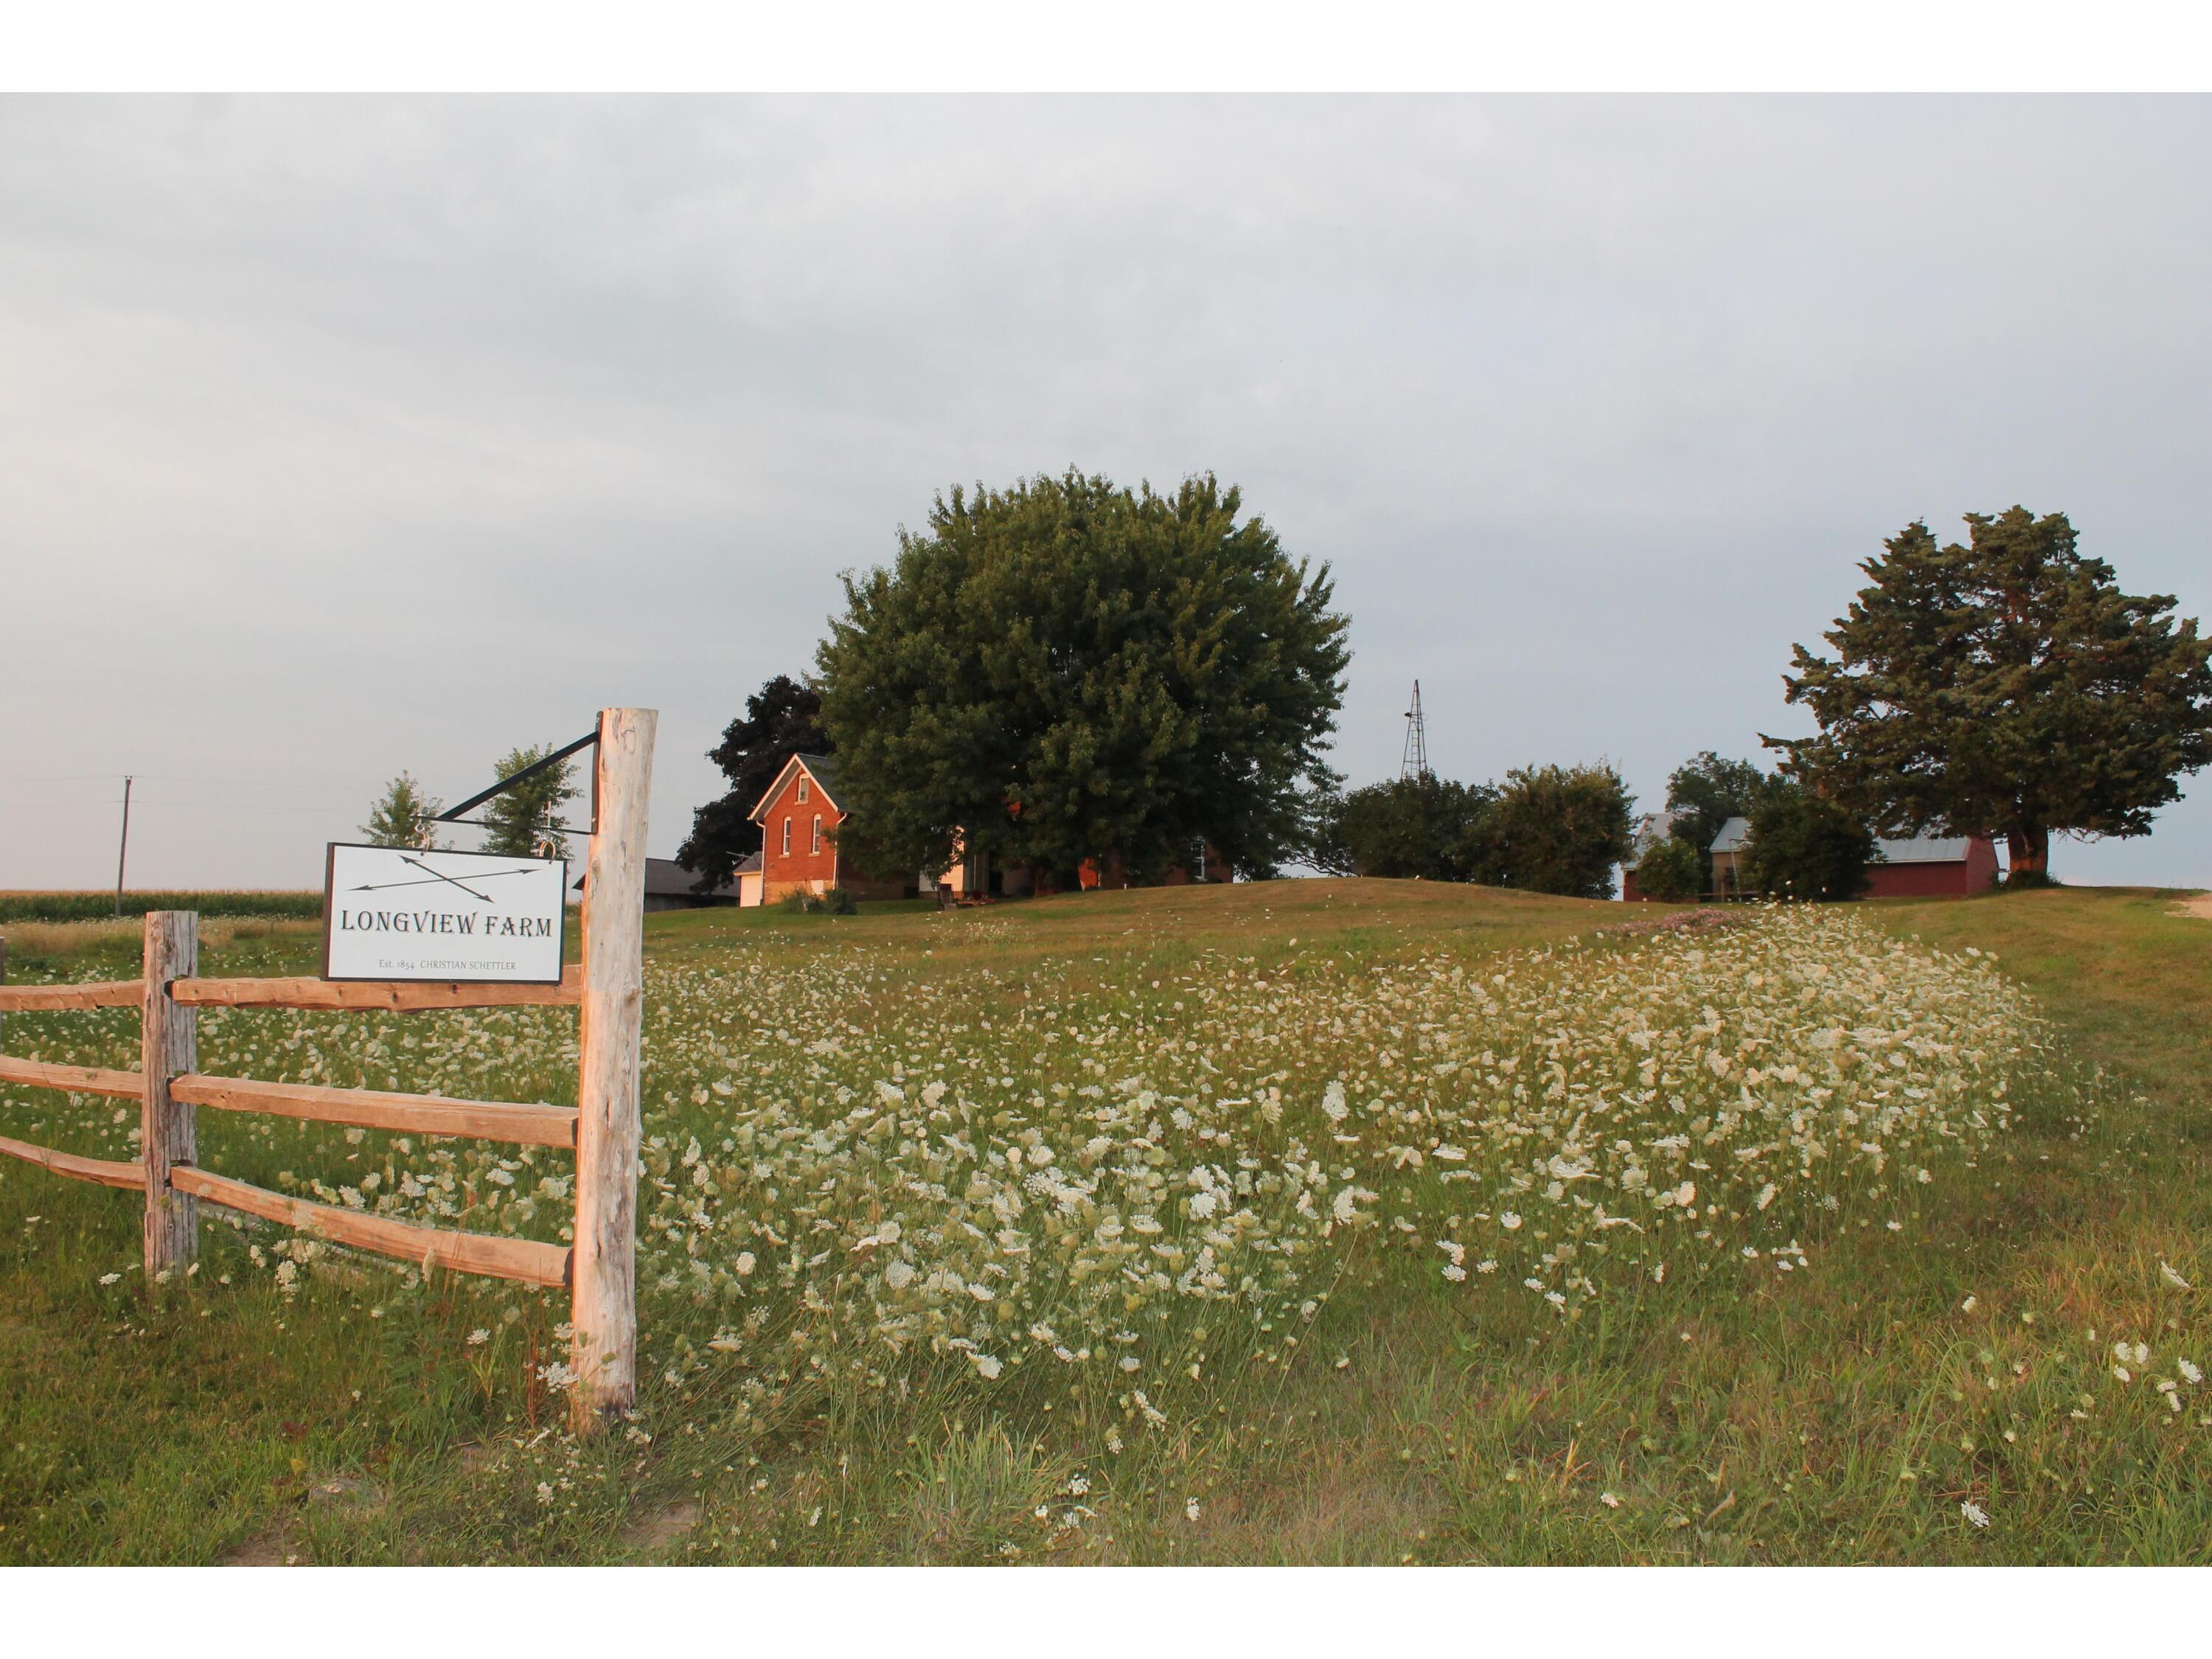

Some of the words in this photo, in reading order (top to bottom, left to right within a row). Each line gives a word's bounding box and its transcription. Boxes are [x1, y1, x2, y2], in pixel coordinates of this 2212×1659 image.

[341, 909, 479, 935] LONGVIEW
[484, 915, 552, 937] FARM
[379, 959, 394, 968] Est.
[397, 960, 414, 970] 1854
[420, 960, 467, 970] CHRISTIAN
[468, 961, 516, 970] SCHETTLER
